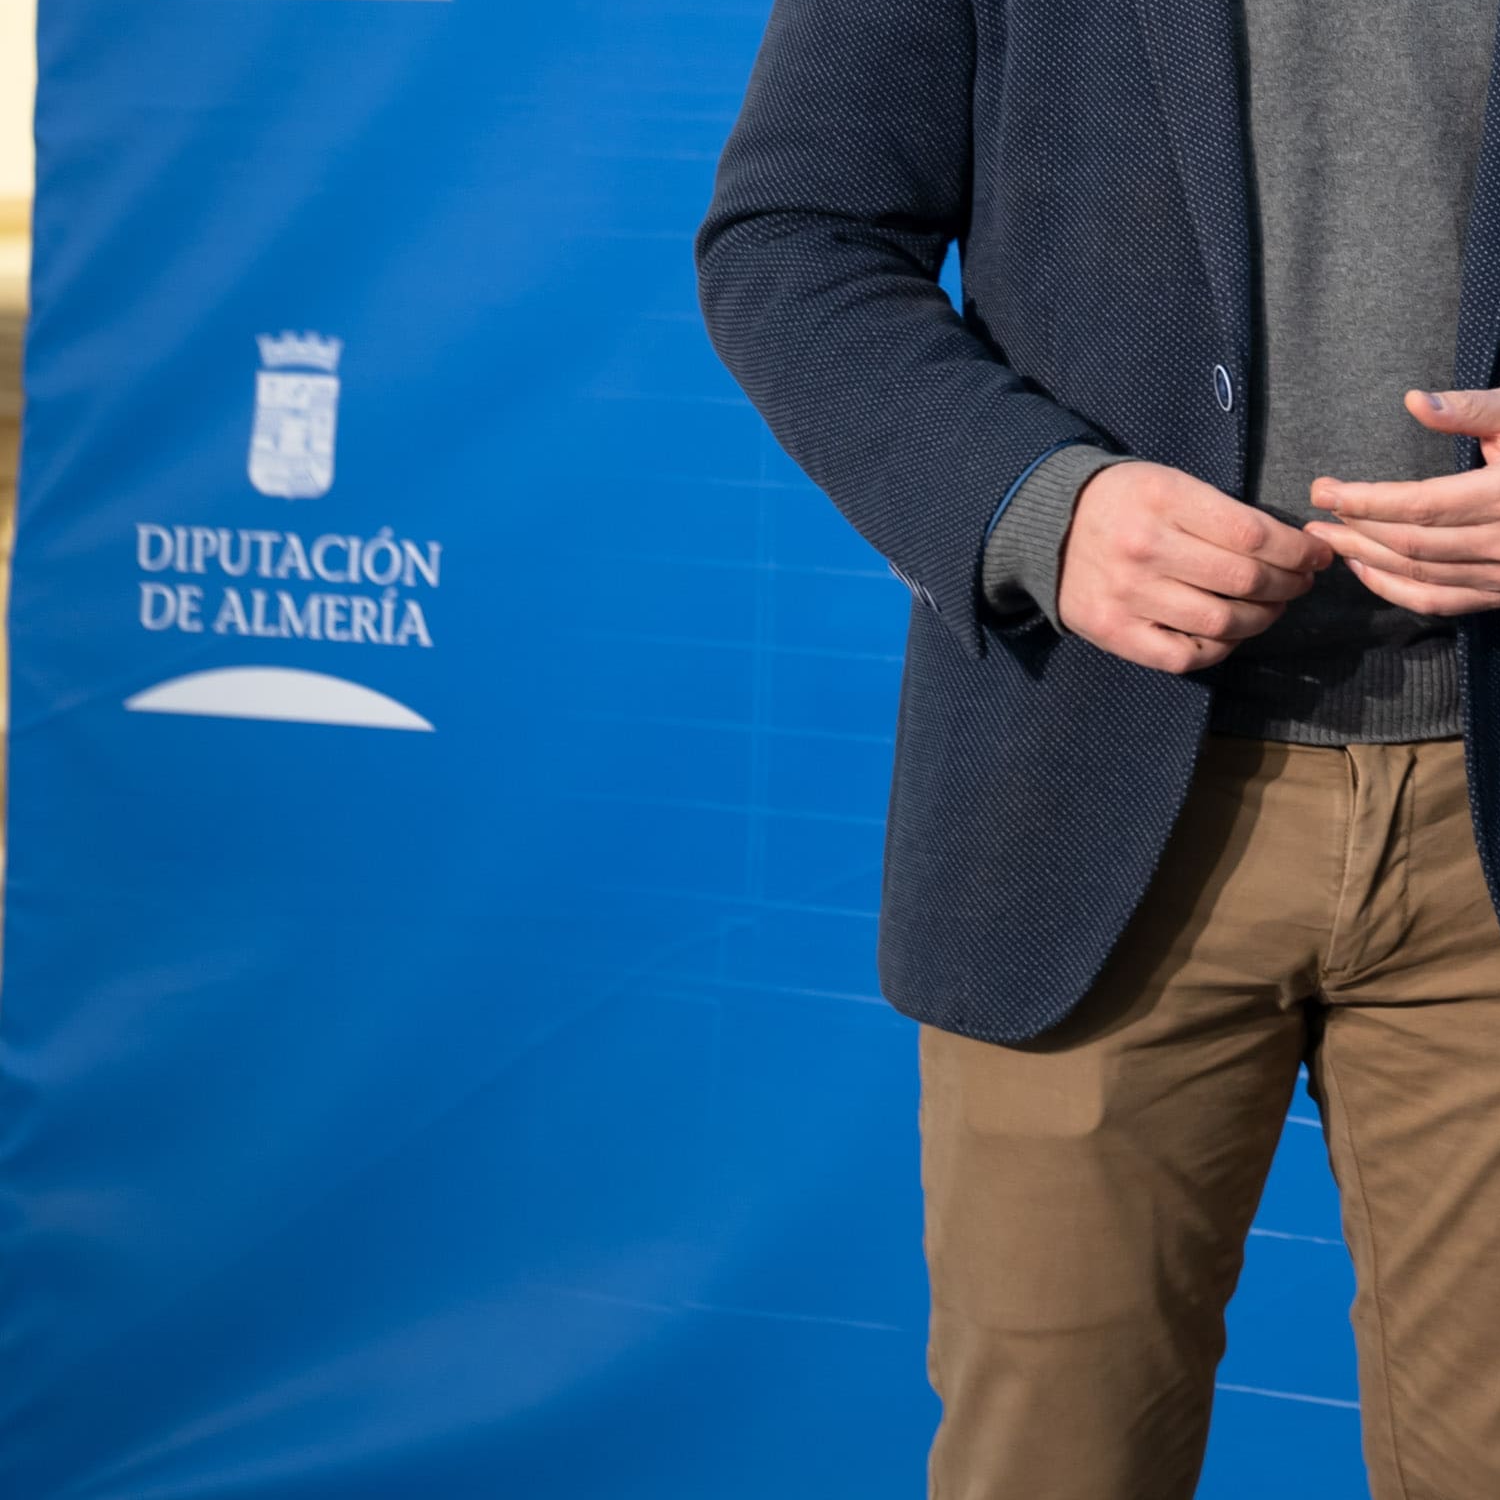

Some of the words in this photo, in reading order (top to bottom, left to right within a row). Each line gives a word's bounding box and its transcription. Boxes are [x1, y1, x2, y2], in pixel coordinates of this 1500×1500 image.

[136, 524, 443, 589] DIPUTACIÓN
[139, 581, 205, 633] DE
[213, 586, 434, 648] ALMERÍA
